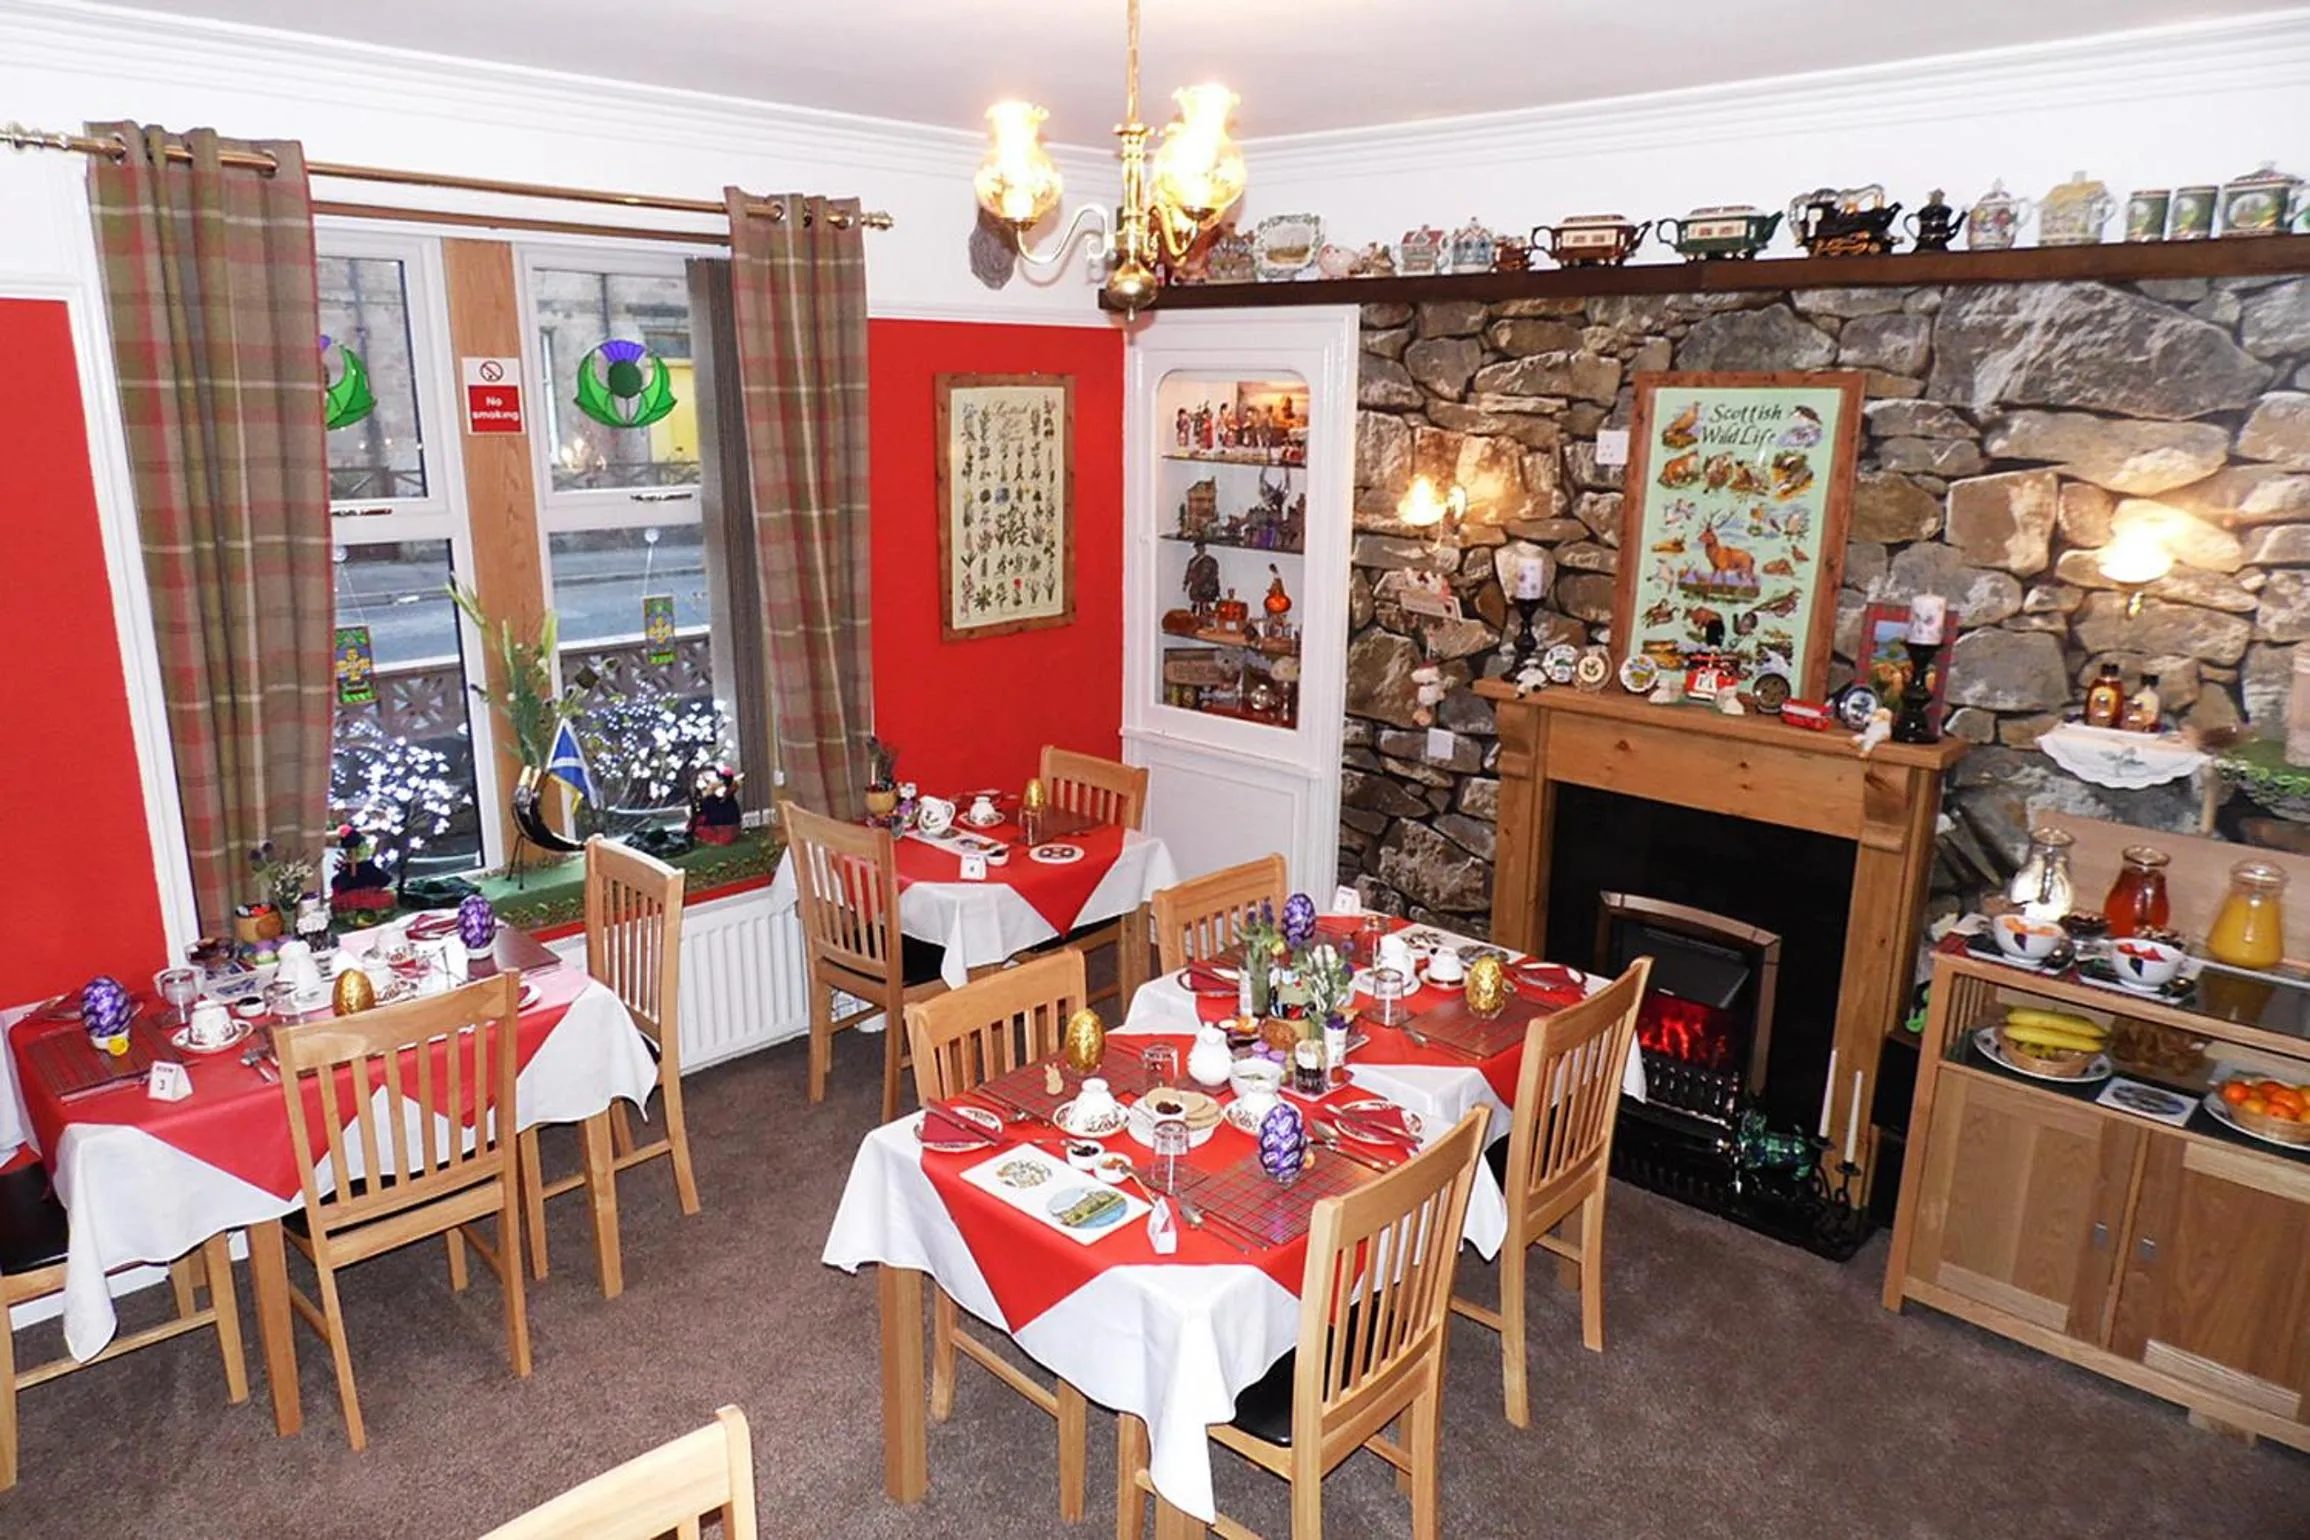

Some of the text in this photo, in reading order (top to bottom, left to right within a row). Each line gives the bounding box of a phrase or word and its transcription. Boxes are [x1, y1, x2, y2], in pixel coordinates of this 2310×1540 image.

[485, 396, 503, 407] No
[472, 410, 519, 421] smoking
[1709, 403, 1782, 424] Scottish
